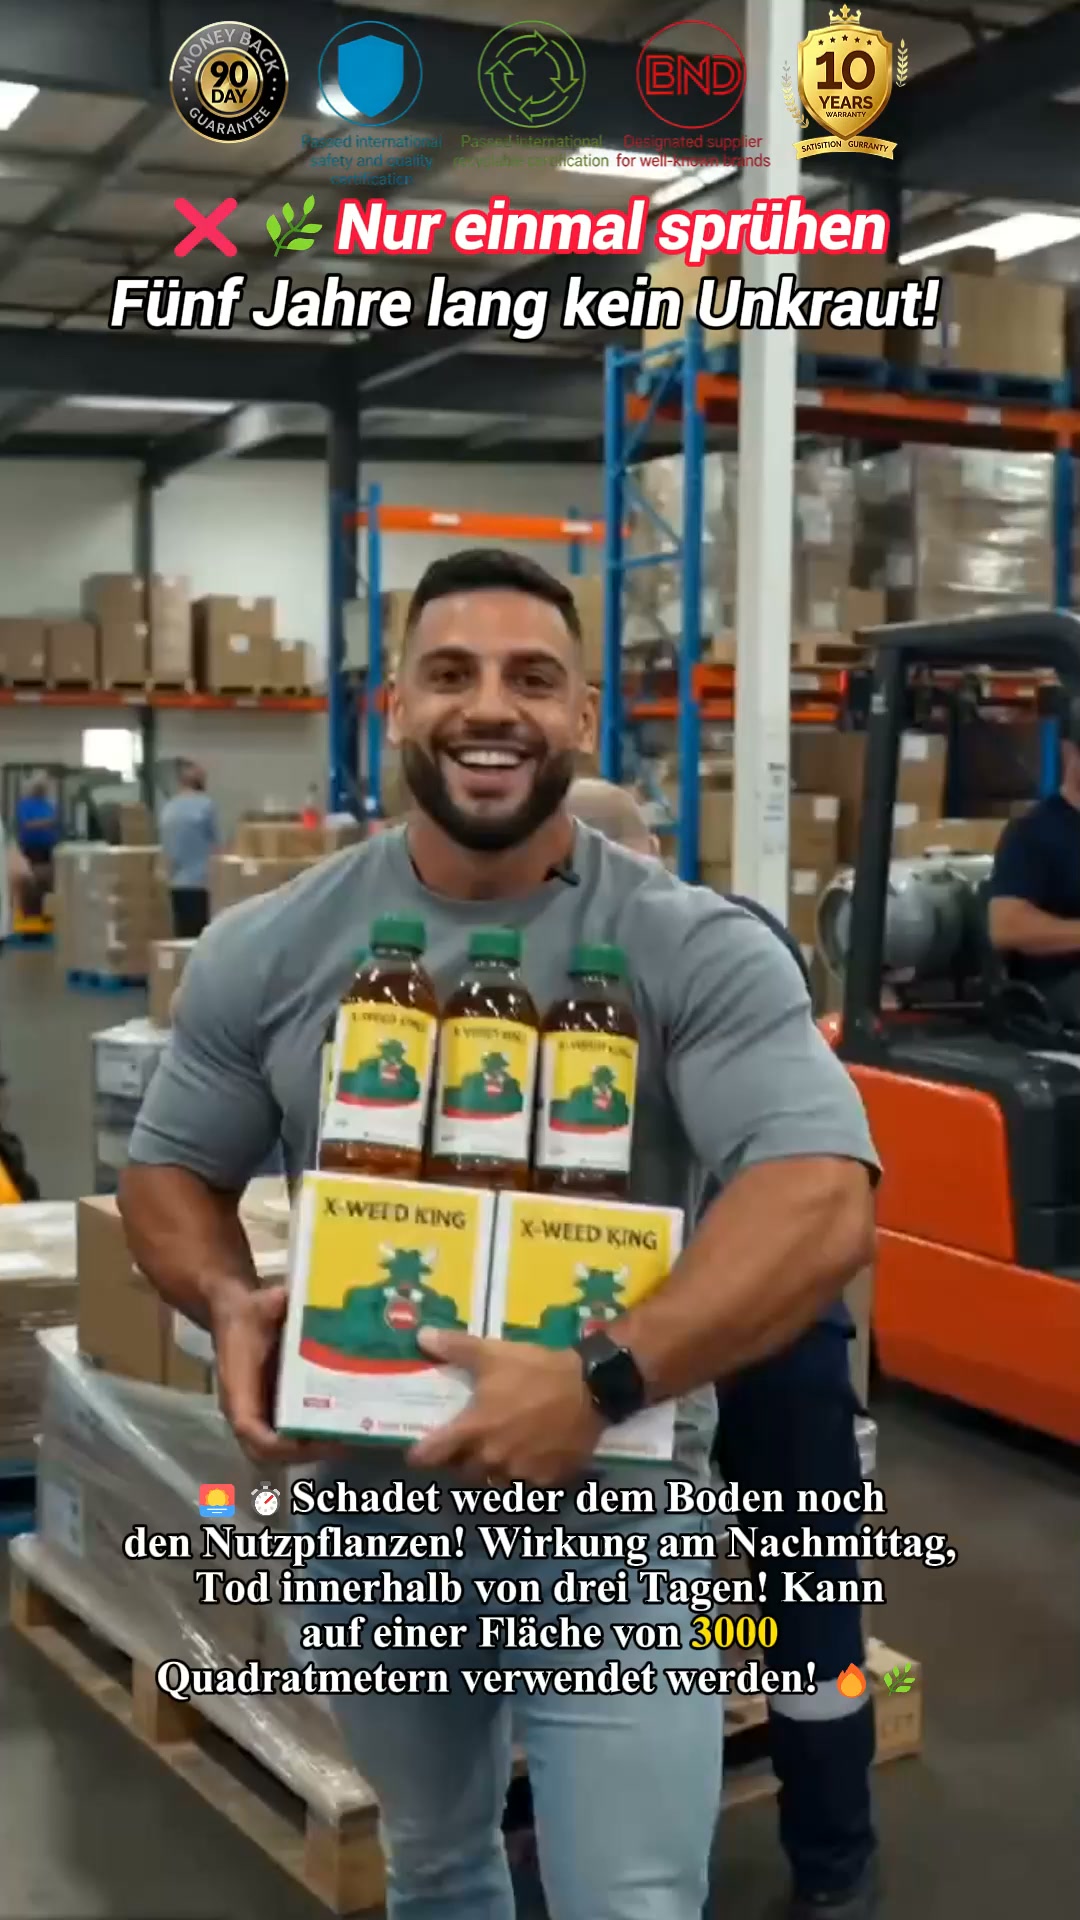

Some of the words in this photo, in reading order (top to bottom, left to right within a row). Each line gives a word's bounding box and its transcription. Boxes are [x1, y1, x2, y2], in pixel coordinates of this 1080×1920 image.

[414, 1204, 467, 1230] KING
[519, 1218, 602, 1243] X-WEED
[606, 1226, 658, 1251] KING
